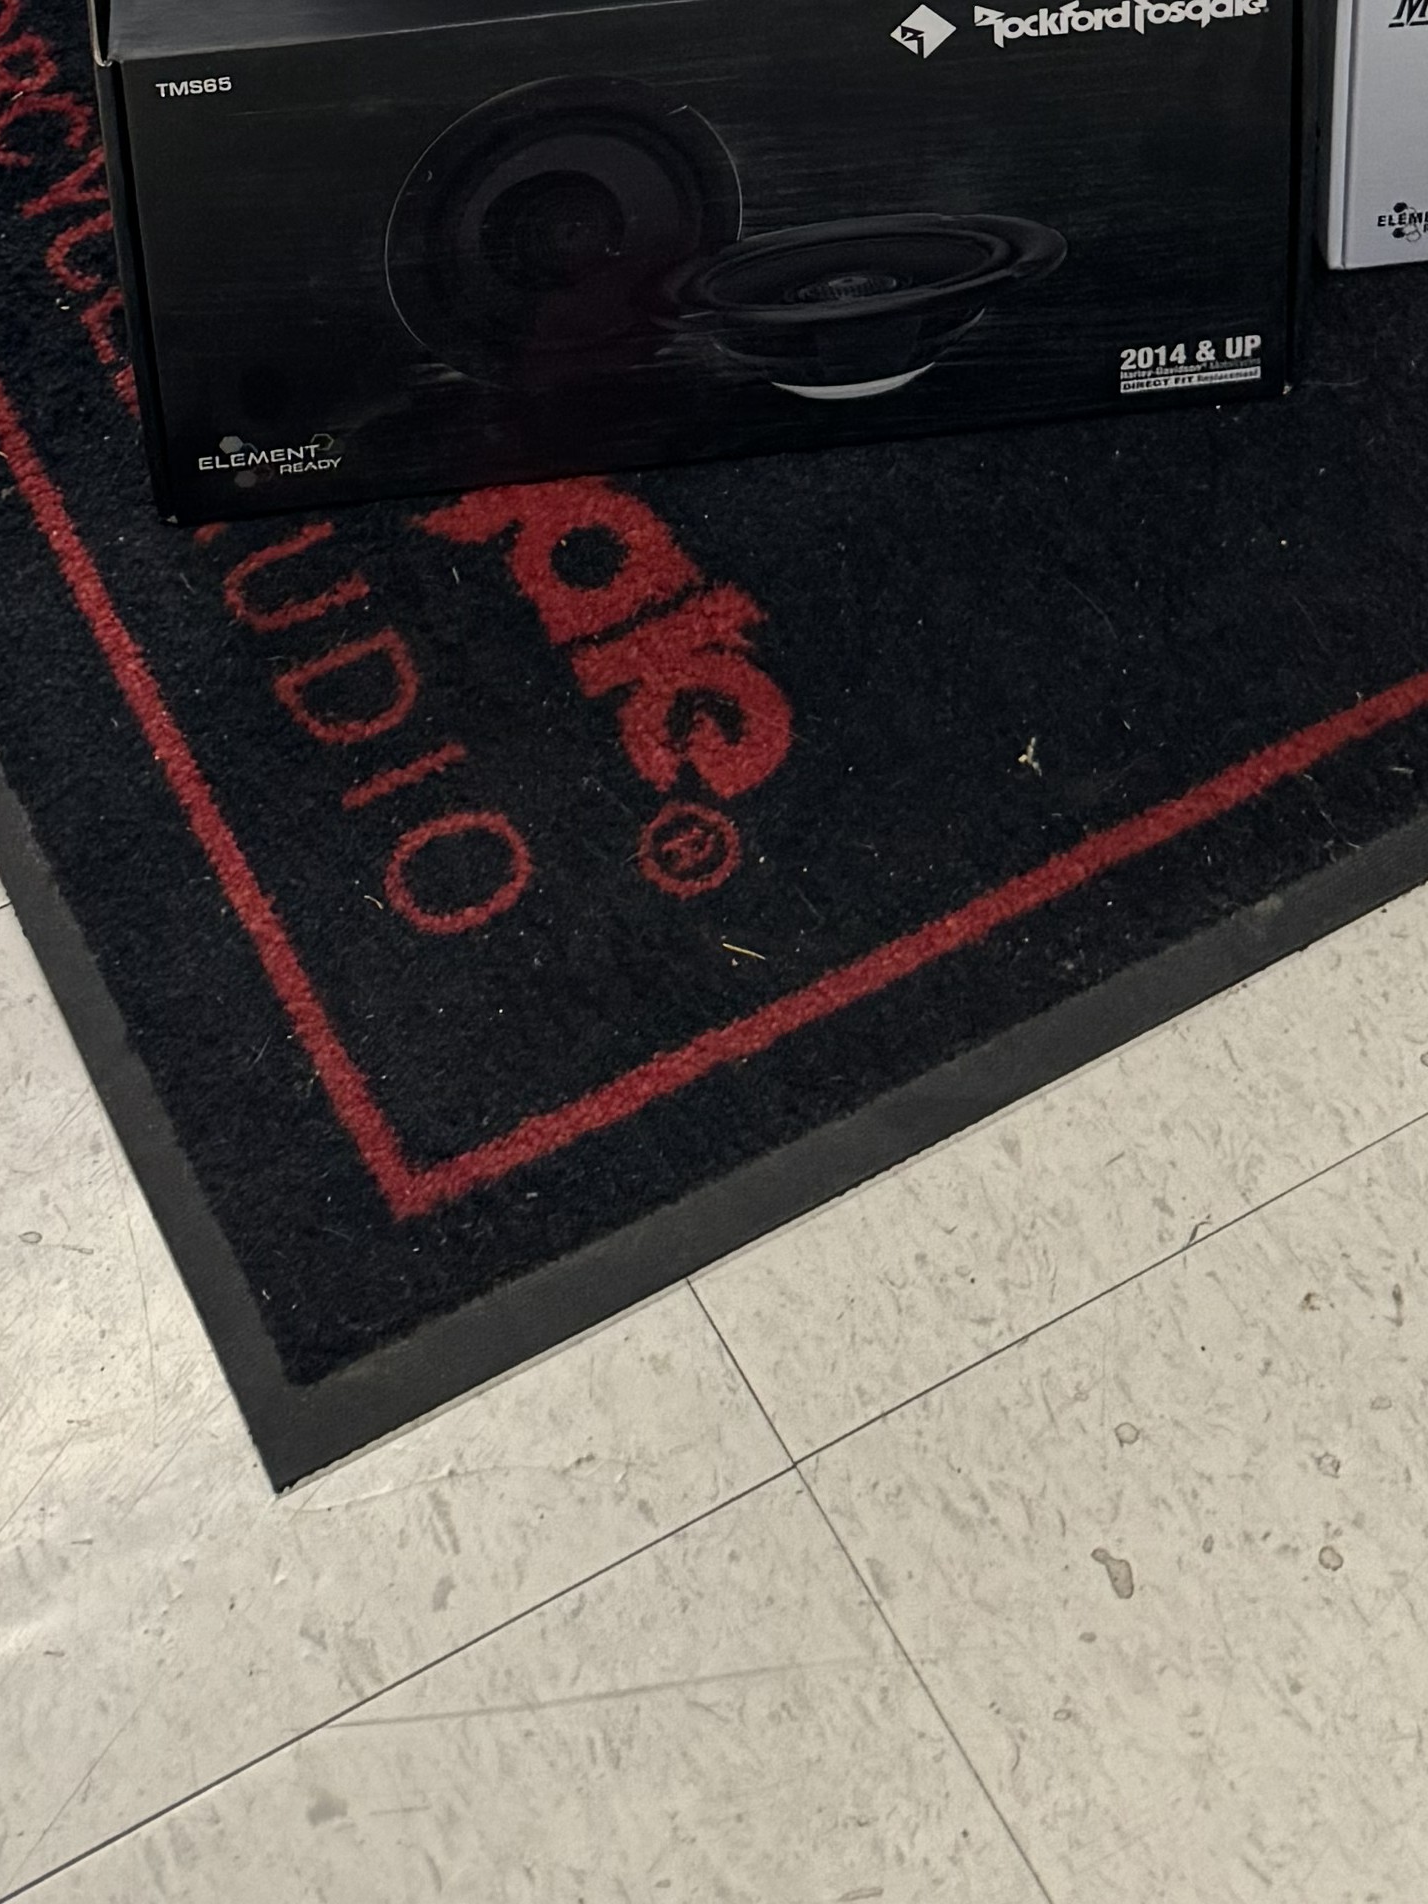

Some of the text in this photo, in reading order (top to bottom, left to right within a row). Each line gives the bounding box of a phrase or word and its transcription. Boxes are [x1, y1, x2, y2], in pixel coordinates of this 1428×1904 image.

[974, 0, 1130, 48] Rockford
[156, 77, 232, 98] TMS65
[1120, 334, 1262, 370] 2014 & UP
[1122, 377, 1170, 391] DIRECT
[1174, 375, 1195, 385] FIT
[198, 444, 319, 472] ELEMENT
[279, 456, 343, 475] READY
[192, 520, 535, 934] UDIO
